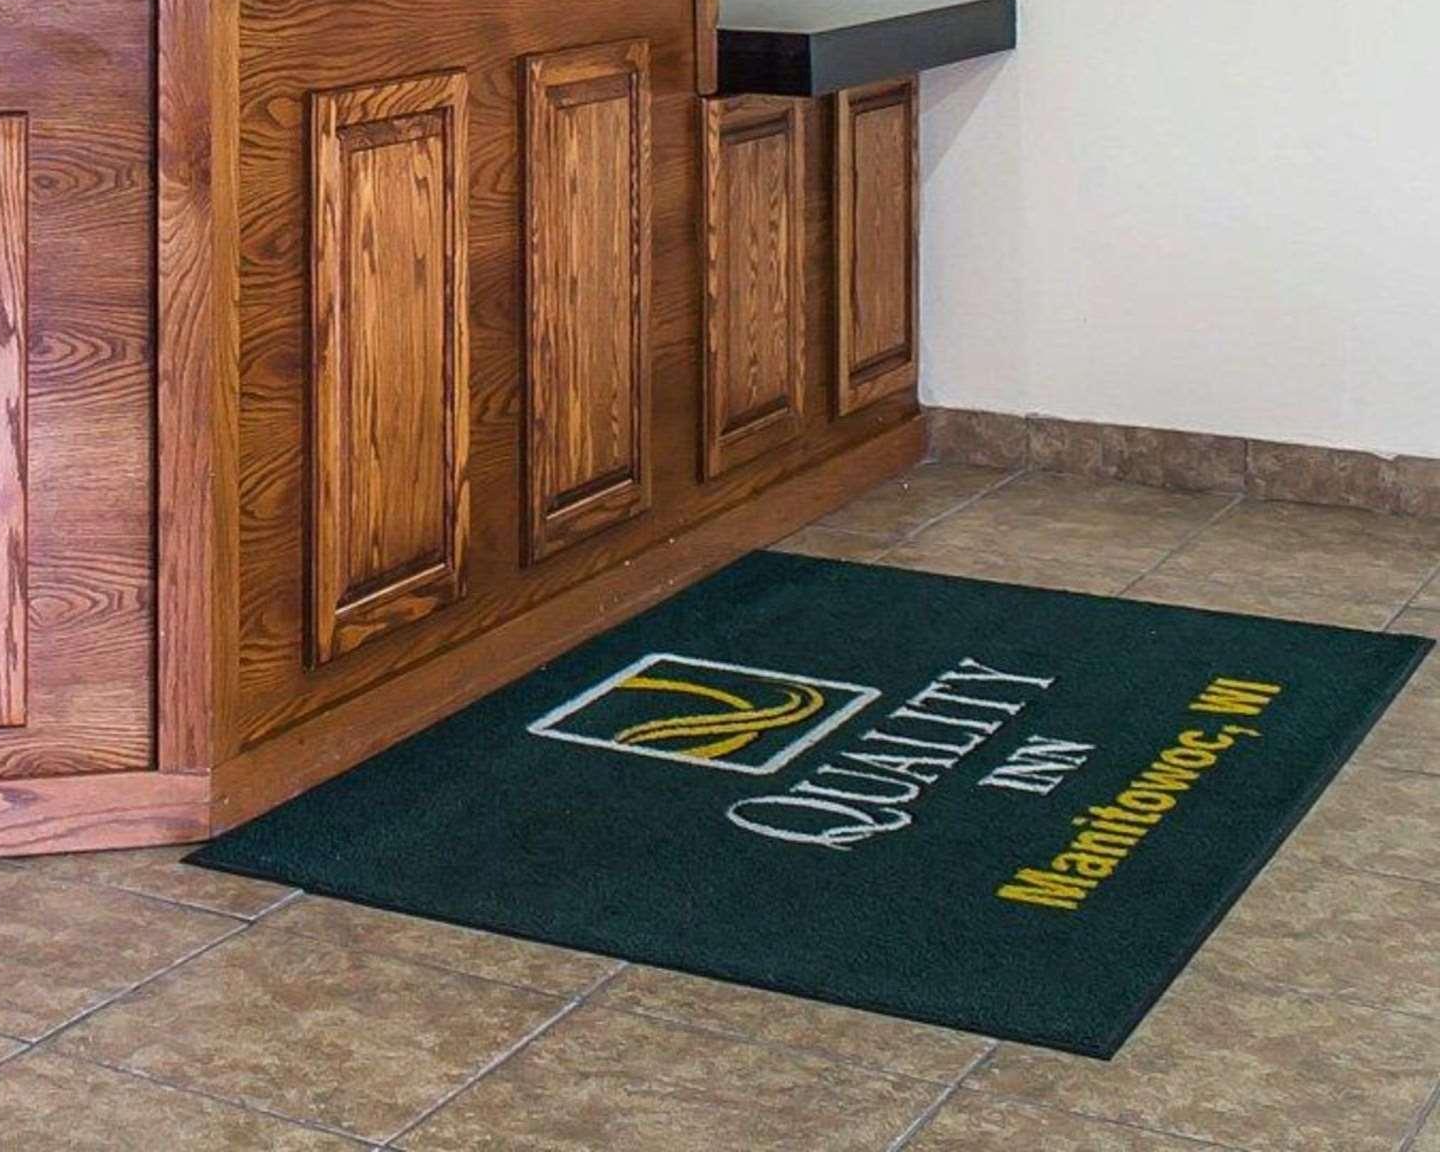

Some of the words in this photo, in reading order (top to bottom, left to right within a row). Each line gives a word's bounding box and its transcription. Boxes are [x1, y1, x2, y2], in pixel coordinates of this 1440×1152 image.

[725, 657, 1057, 850] QUALITY
[977, 734, 1097, 795] INN
[996, 724, 1262, 910] Manitowoc,
[1187, 677, 1283, 716] WI
